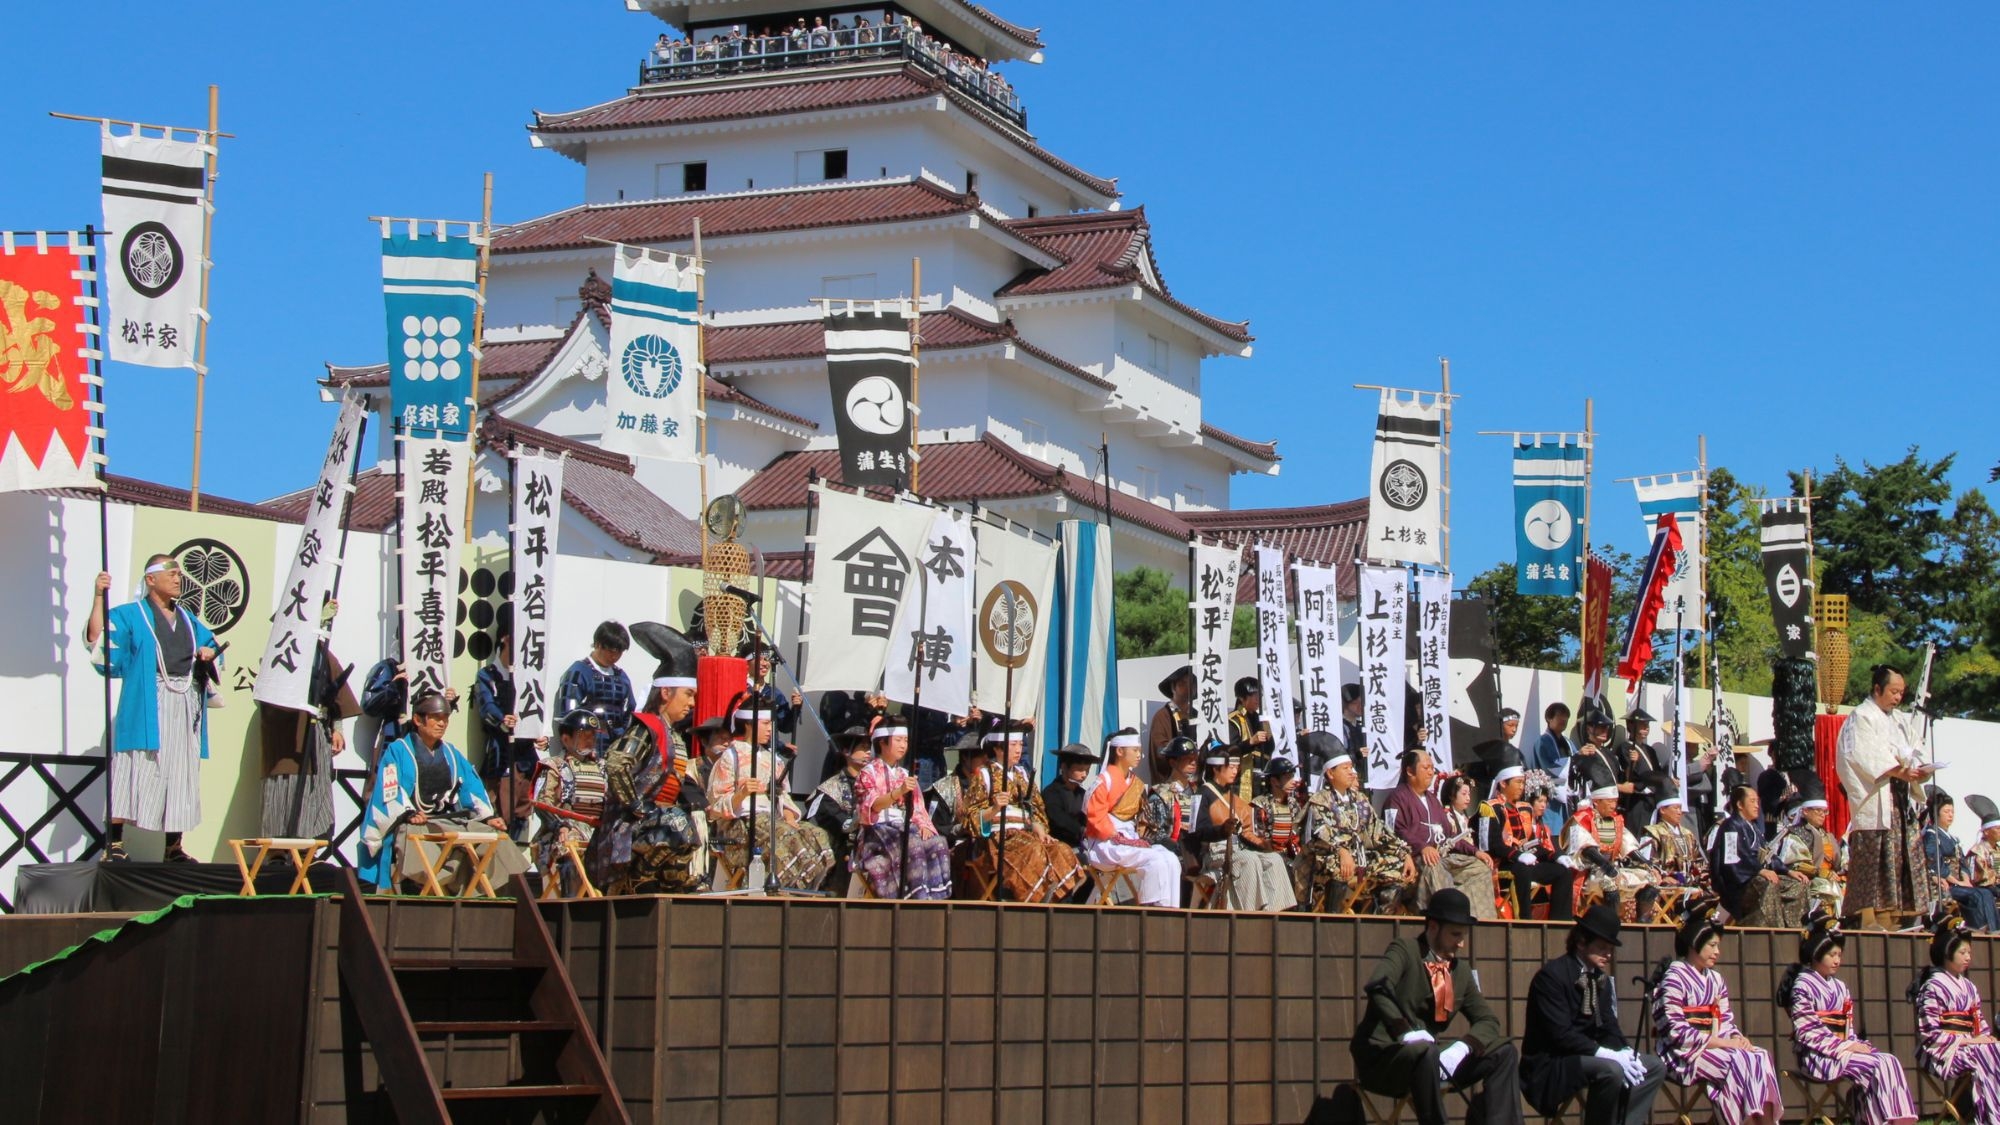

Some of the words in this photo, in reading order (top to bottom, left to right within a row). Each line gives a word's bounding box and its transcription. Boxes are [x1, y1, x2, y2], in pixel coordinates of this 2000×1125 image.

[121, 318, 178, 349] 松平家
[403, 402, 460, 428] 保科家
[616, 410, 679, 437] 加藤家
[1380, 526, 1427, 545] 上杉家
[1526, 563, 1570, 581] 蒲生家
[519, 470, 553, 722] 松平容保公
[907, 535, 964, 681] 本陣
[1391, 581, 1404, 640] 米沢藩主
[1365, 589, 1391, 771] 上杉茂憲公
